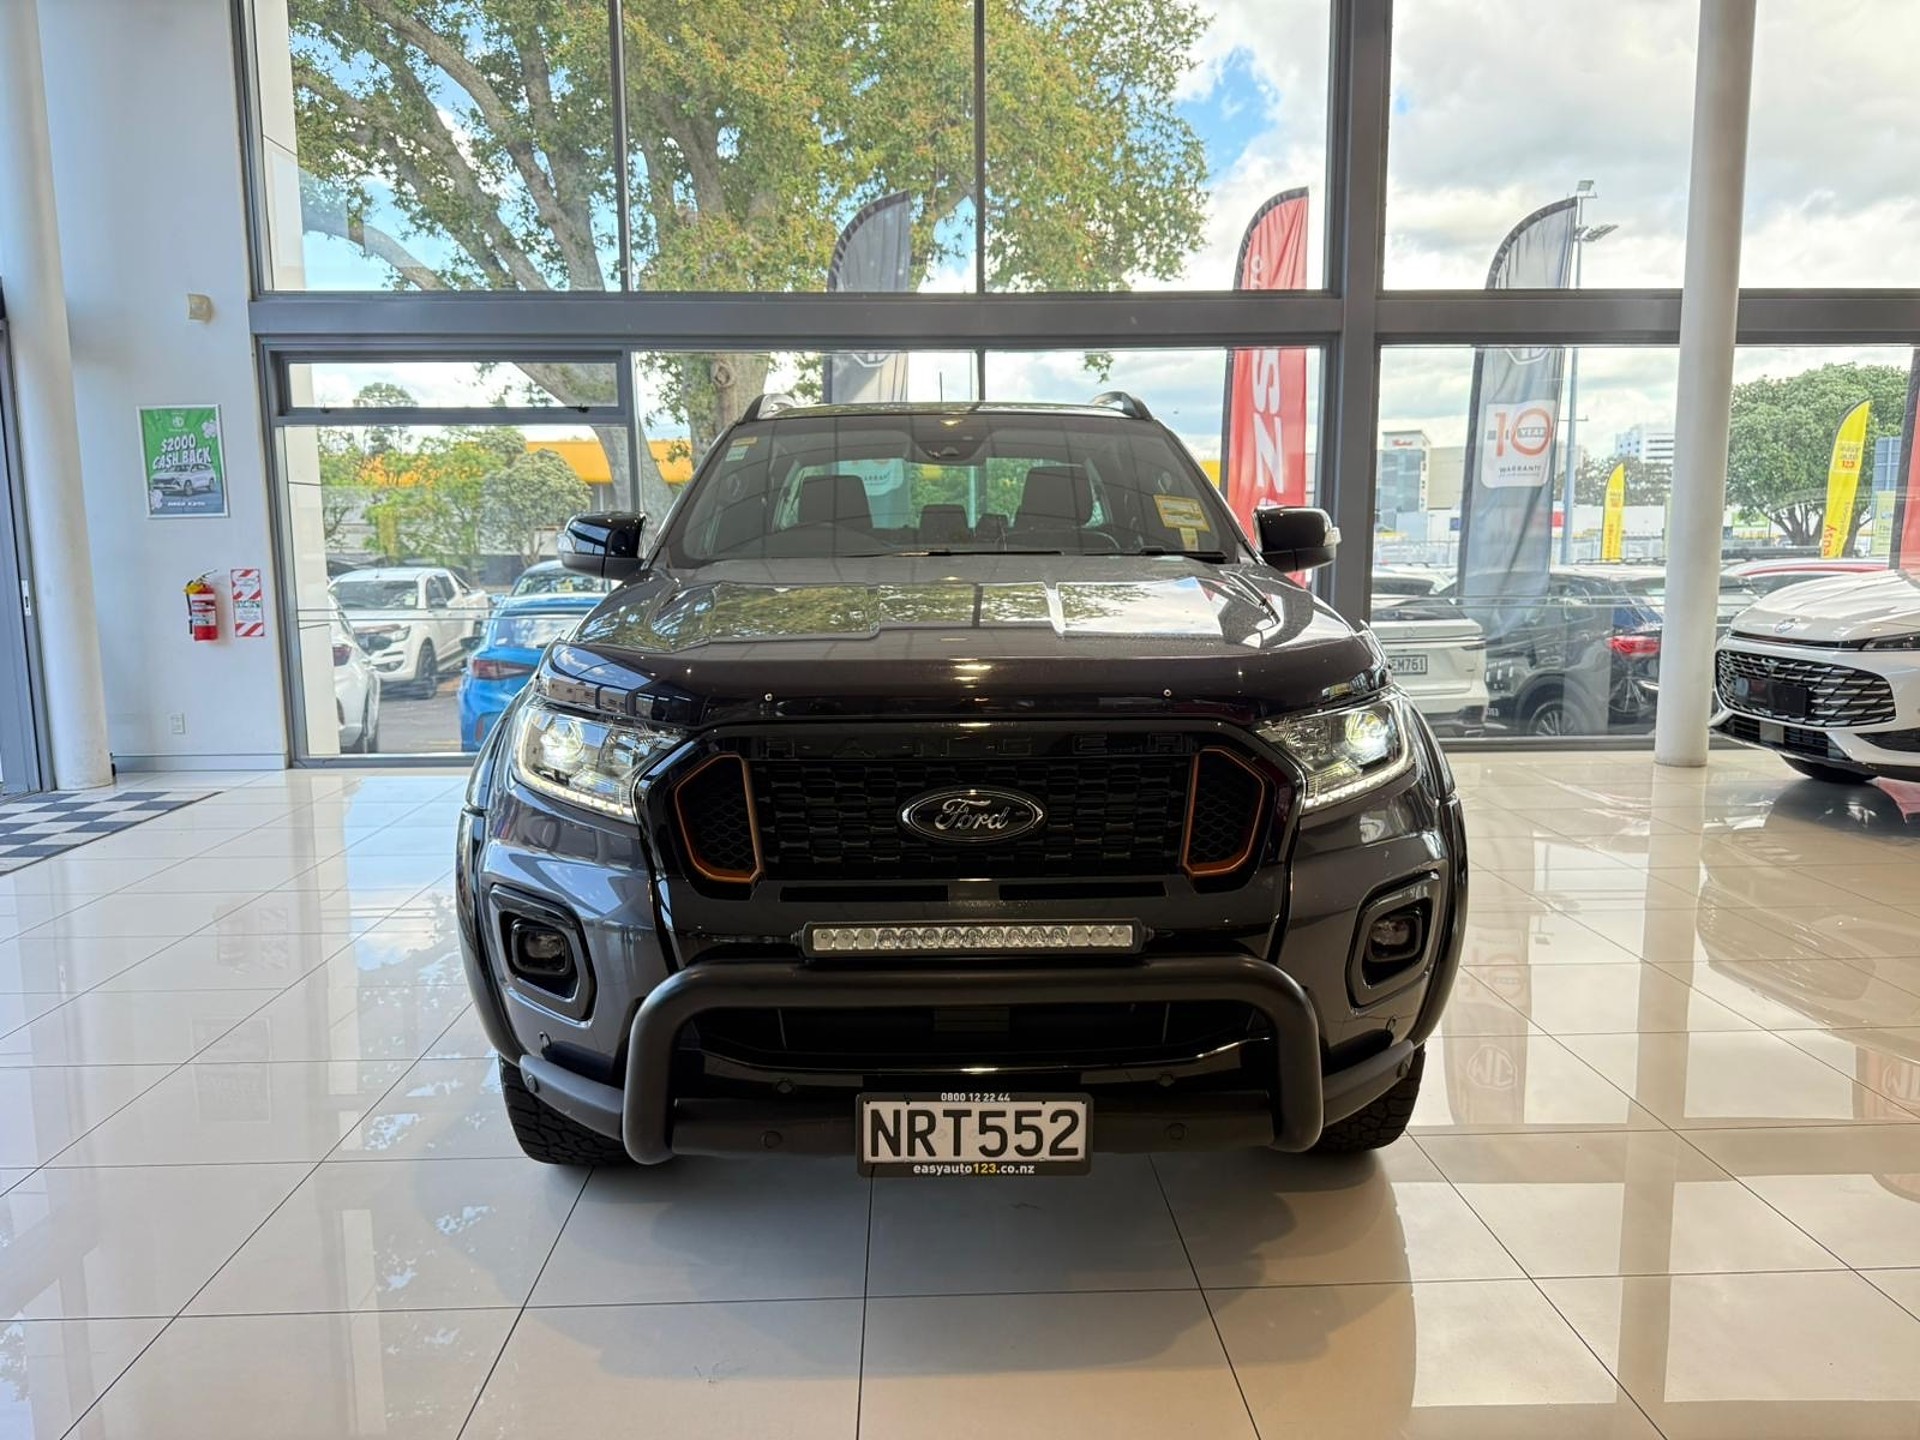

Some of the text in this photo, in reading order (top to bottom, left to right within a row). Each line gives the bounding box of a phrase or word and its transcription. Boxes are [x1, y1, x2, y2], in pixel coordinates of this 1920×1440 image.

[161, 433, 197, 452] $2000
[1495, 407, 1551, 457] 10
[152, 446, 212, 470] CASH BACK
[934, 797, 1010, 831] Ford
[940, 1092, 1011, 1102] 0800 12 22 44
[869, 1108, 1080, 1158] NRT552
[912, 1162, 1035, 1176] easyauto123.co.nz
